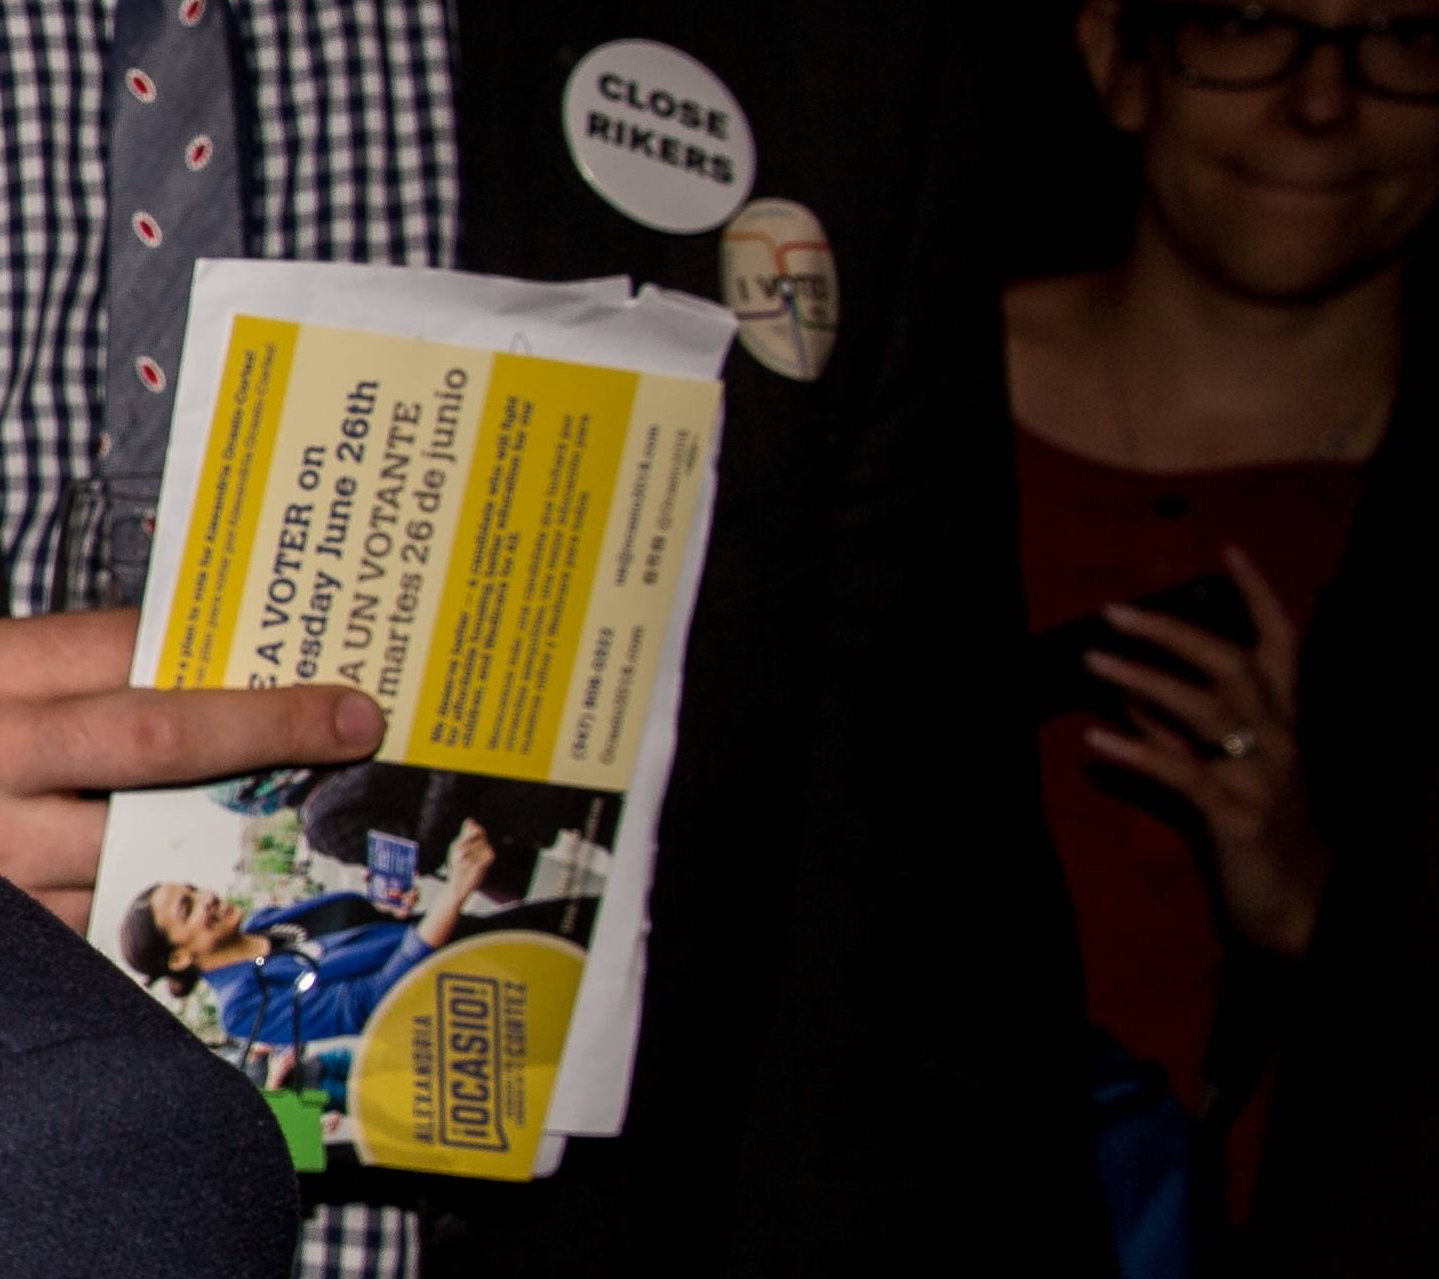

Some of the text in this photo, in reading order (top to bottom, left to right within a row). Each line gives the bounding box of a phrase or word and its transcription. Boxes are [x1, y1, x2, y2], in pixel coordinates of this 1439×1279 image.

[597, 73, 729, 140] CLOSE
[586, 112, 736, 186] RIKERS
[335, 380, 378, 463] 26th
[296, 445, 326, 491] on
[357, 402, 421, 581] VOTANTE
[314, 475, 357, 559] June
[376, 367, 468, 697] martes 26 de junio
[261, 503, 313, 628] VOTER
[255, 640, 285, 666] A
[342, 591, 380, 650] UN
